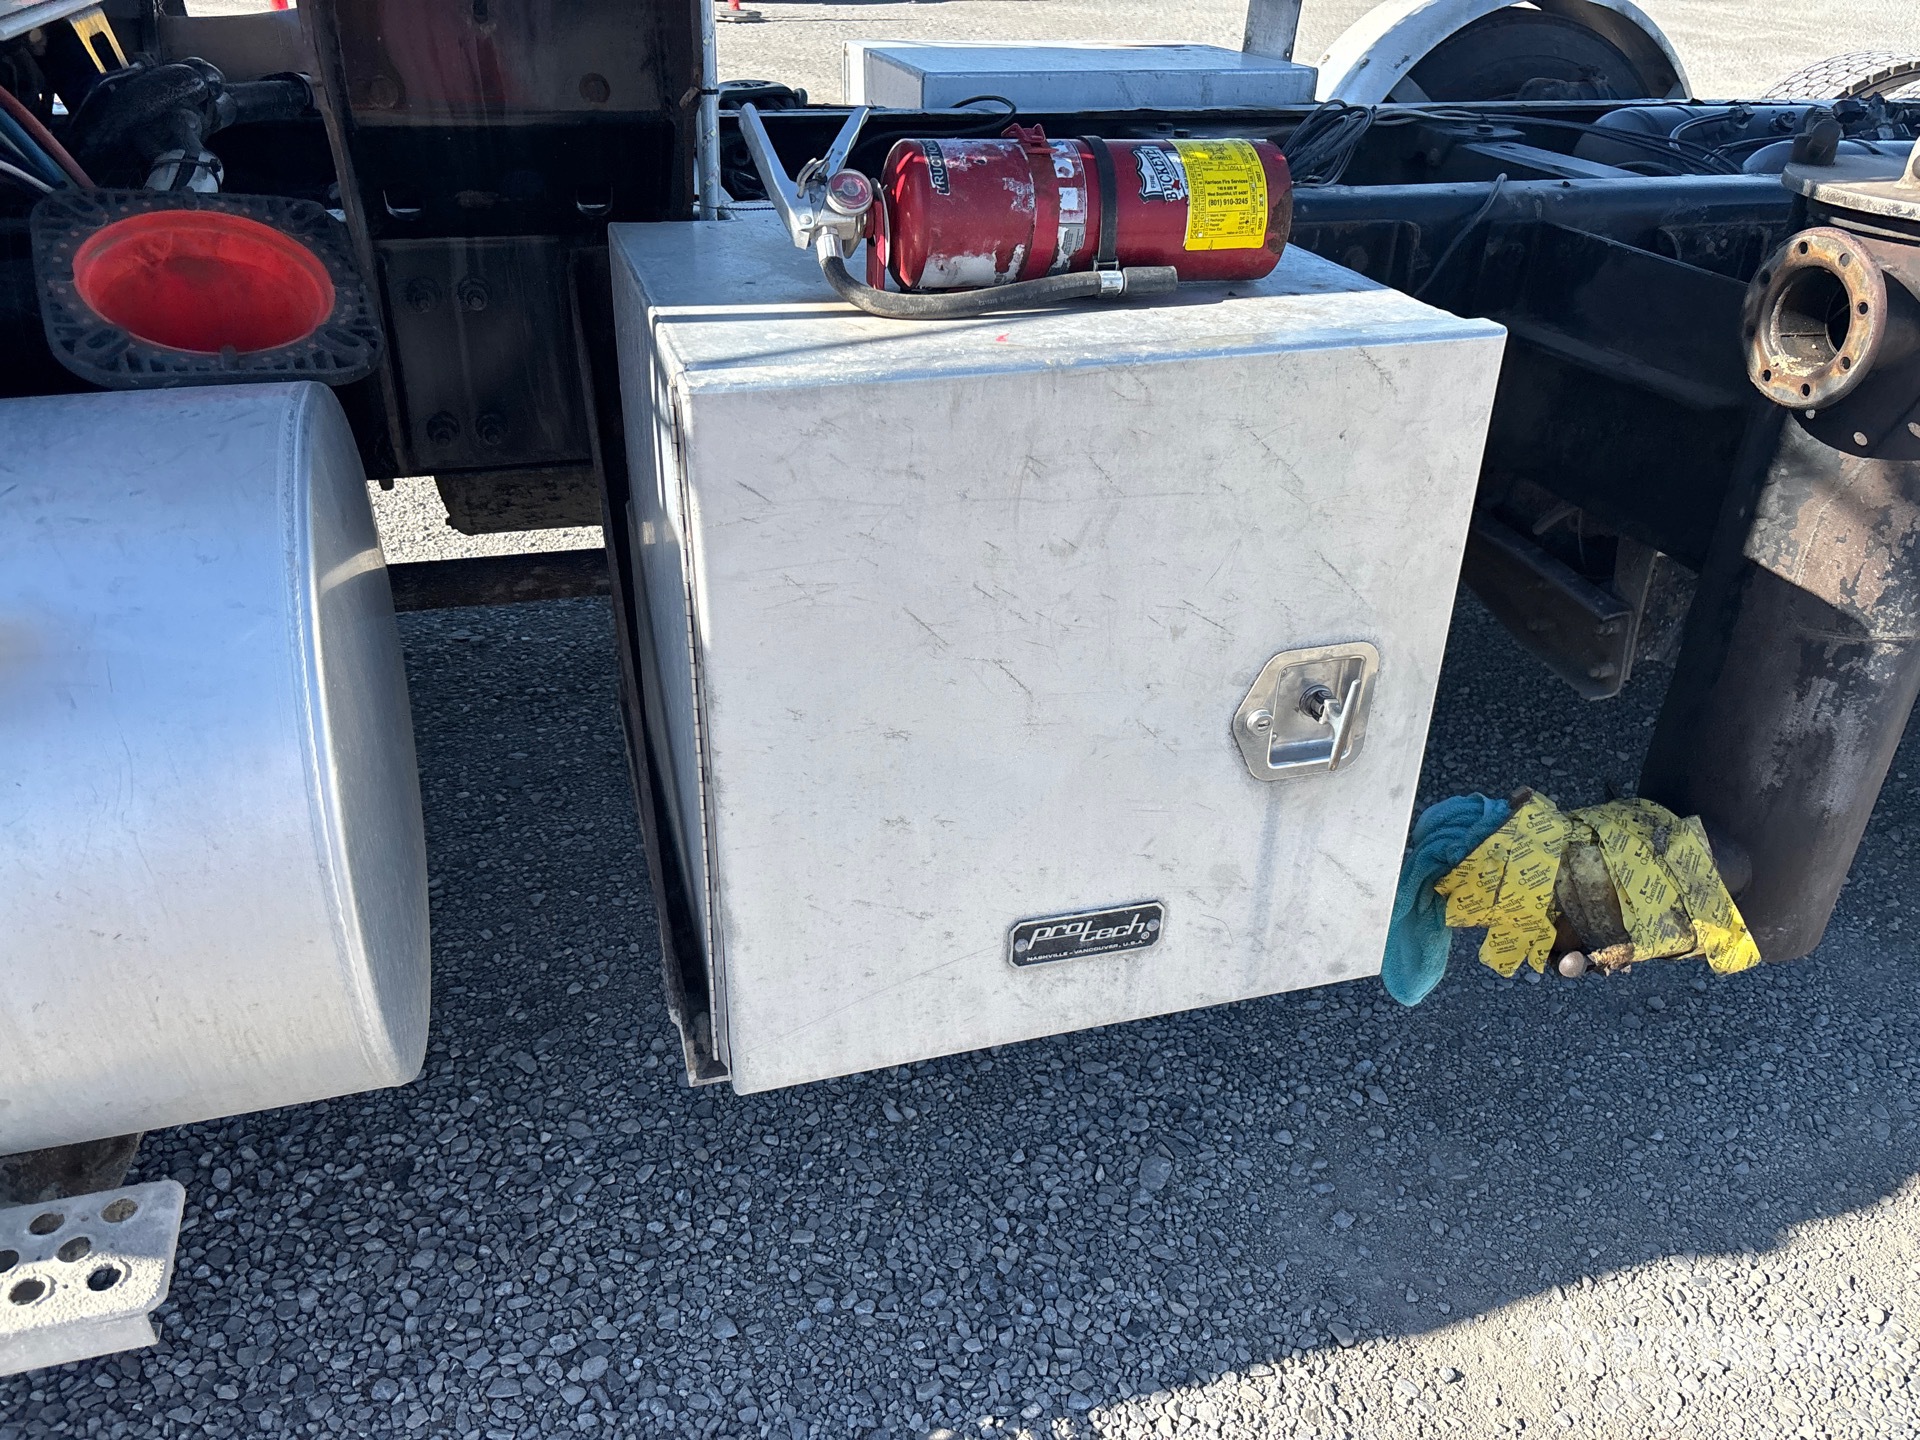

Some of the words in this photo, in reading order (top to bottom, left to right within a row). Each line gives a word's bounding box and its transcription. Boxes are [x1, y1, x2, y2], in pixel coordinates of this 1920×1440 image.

[1143, 150, 1179, 200] BUCKEYE
[1208, 199, 1223, 207] (801)
[1223, 197, 1249, 206] 910-3245
[1027, 913, 1146, 951] protech
[1026, 951, 1068, 962] NASHVILLE
[1122, 939, 1146, 948] U.S.A.
